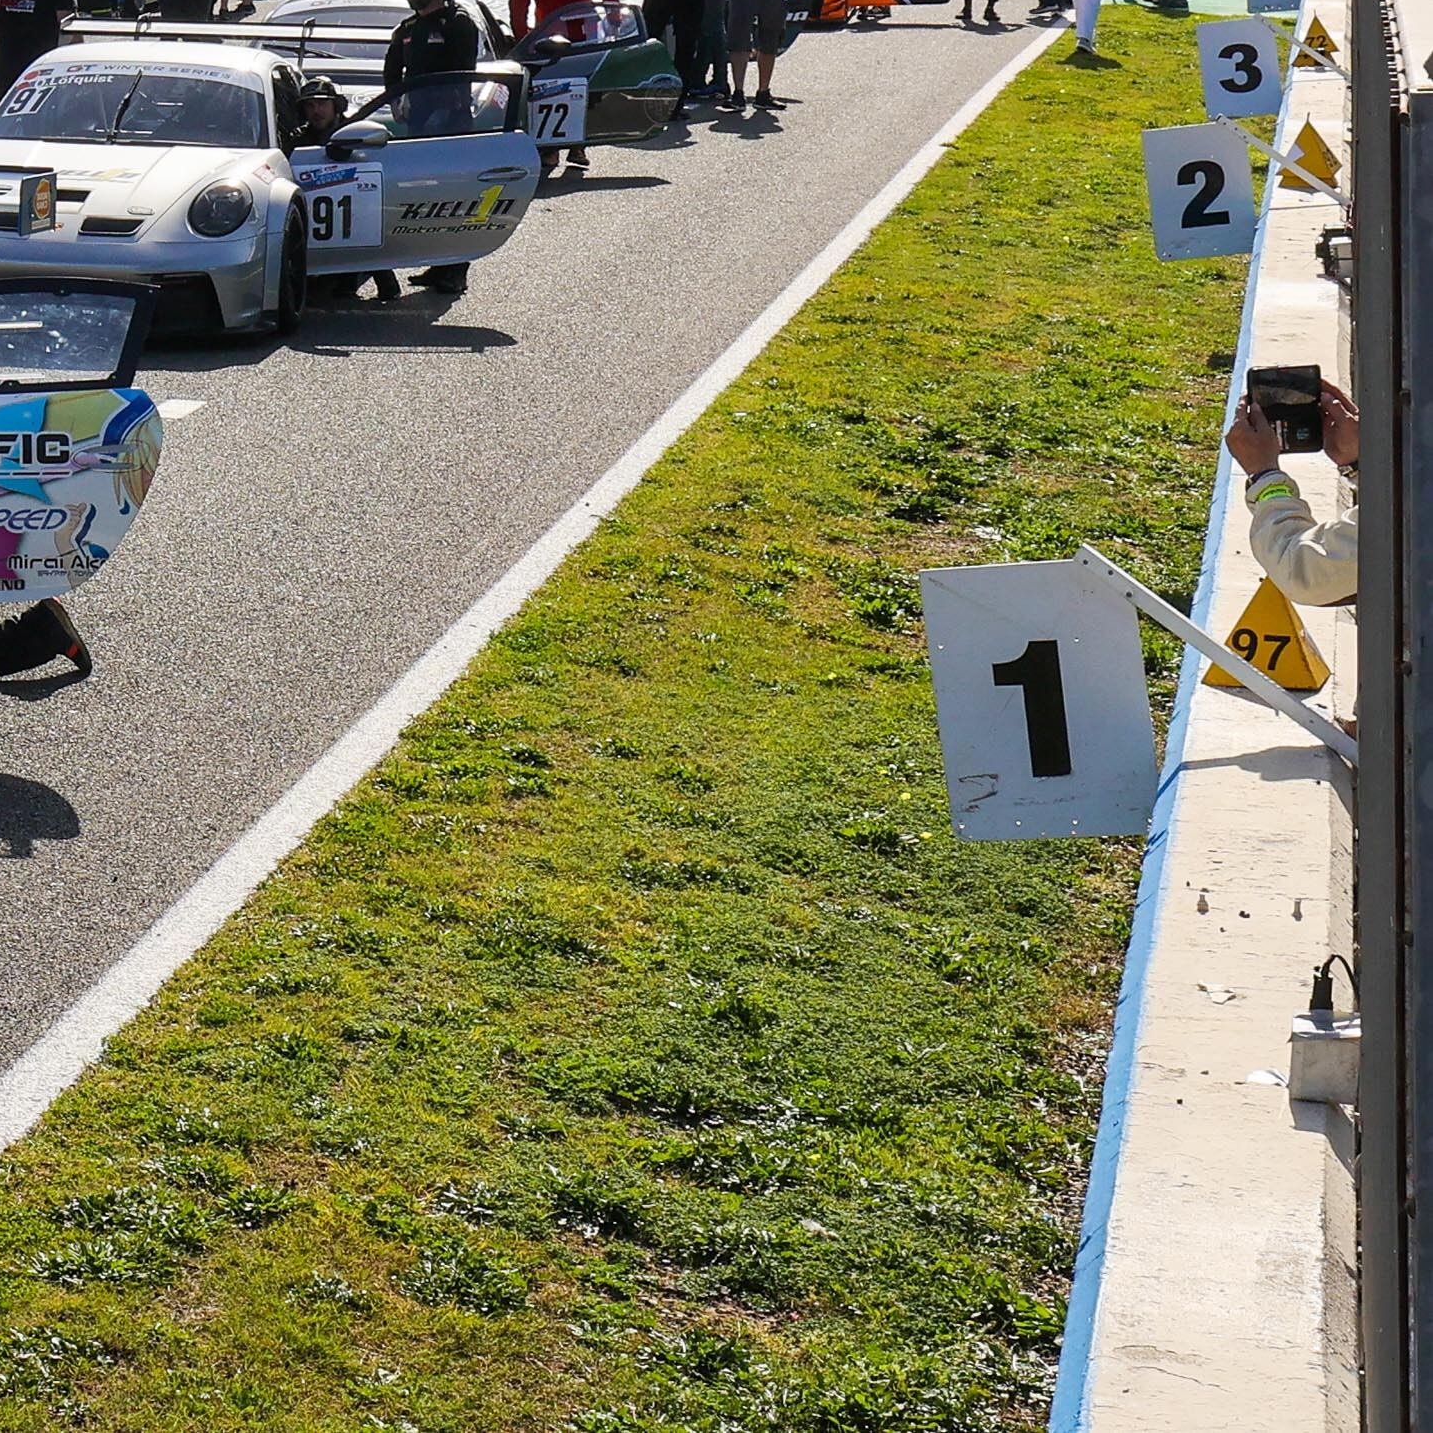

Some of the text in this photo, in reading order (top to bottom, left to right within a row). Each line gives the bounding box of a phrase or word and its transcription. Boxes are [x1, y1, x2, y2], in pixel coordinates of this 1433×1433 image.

[1305, 35, 1329, 48] 72
[65, 64, 99, 73] GT
[102, 64, 169, 74] WINTER
[1218, 44, 1263, 94] 3
[6, 87, 57, 115] 91
[535, 104, 570, 140] 72
[1176, 161, 1231, 229] 2
[312, 195, 352, 241] 91
[392, 222, 508, 235] Motorsports
[8, 554, 65, 569] Mirai
[1232, 628, 1292, 671] 97
[992, 639, 1072, 777] 1
